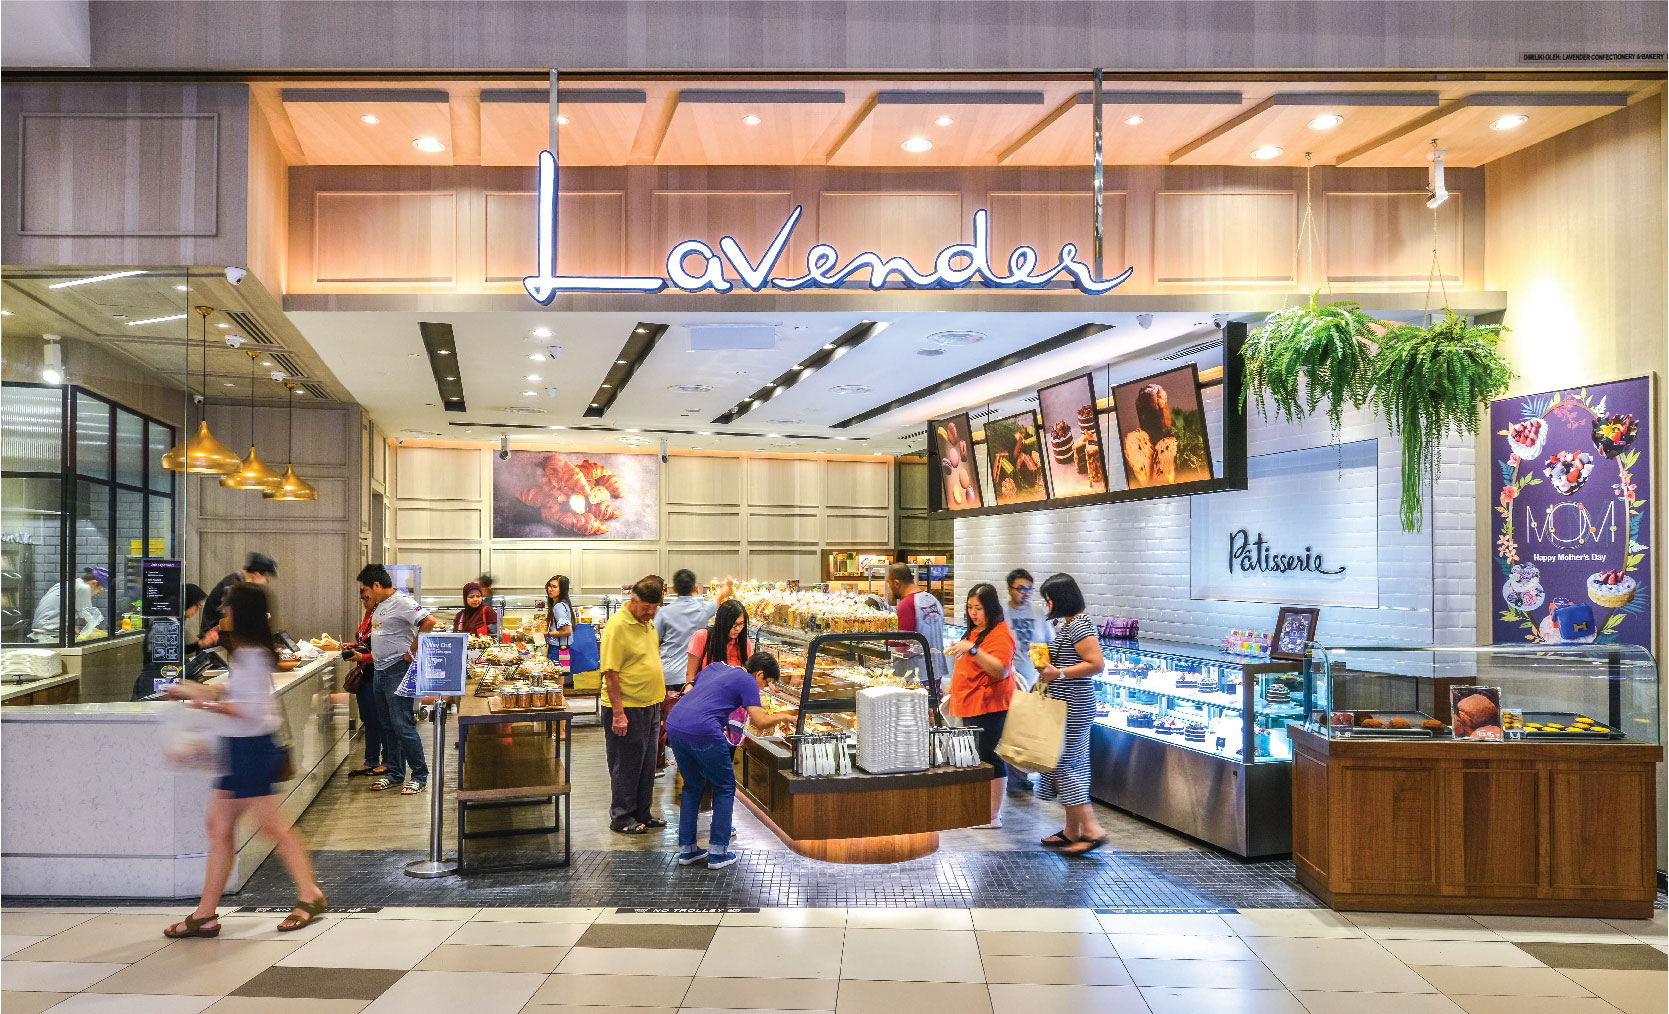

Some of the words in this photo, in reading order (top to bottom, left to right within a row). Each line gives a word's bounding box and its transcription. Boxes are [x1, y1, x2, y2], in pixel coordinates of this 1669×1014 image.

[1526, 501, 1616, 545] MOM
[1228, 528, 1347, 575] Pâtisserie
[1533, 553, 1556, 563] Happy
[1557, 553, 1590, 561] Mother's
[1591, 553, 1607, 563] Day
